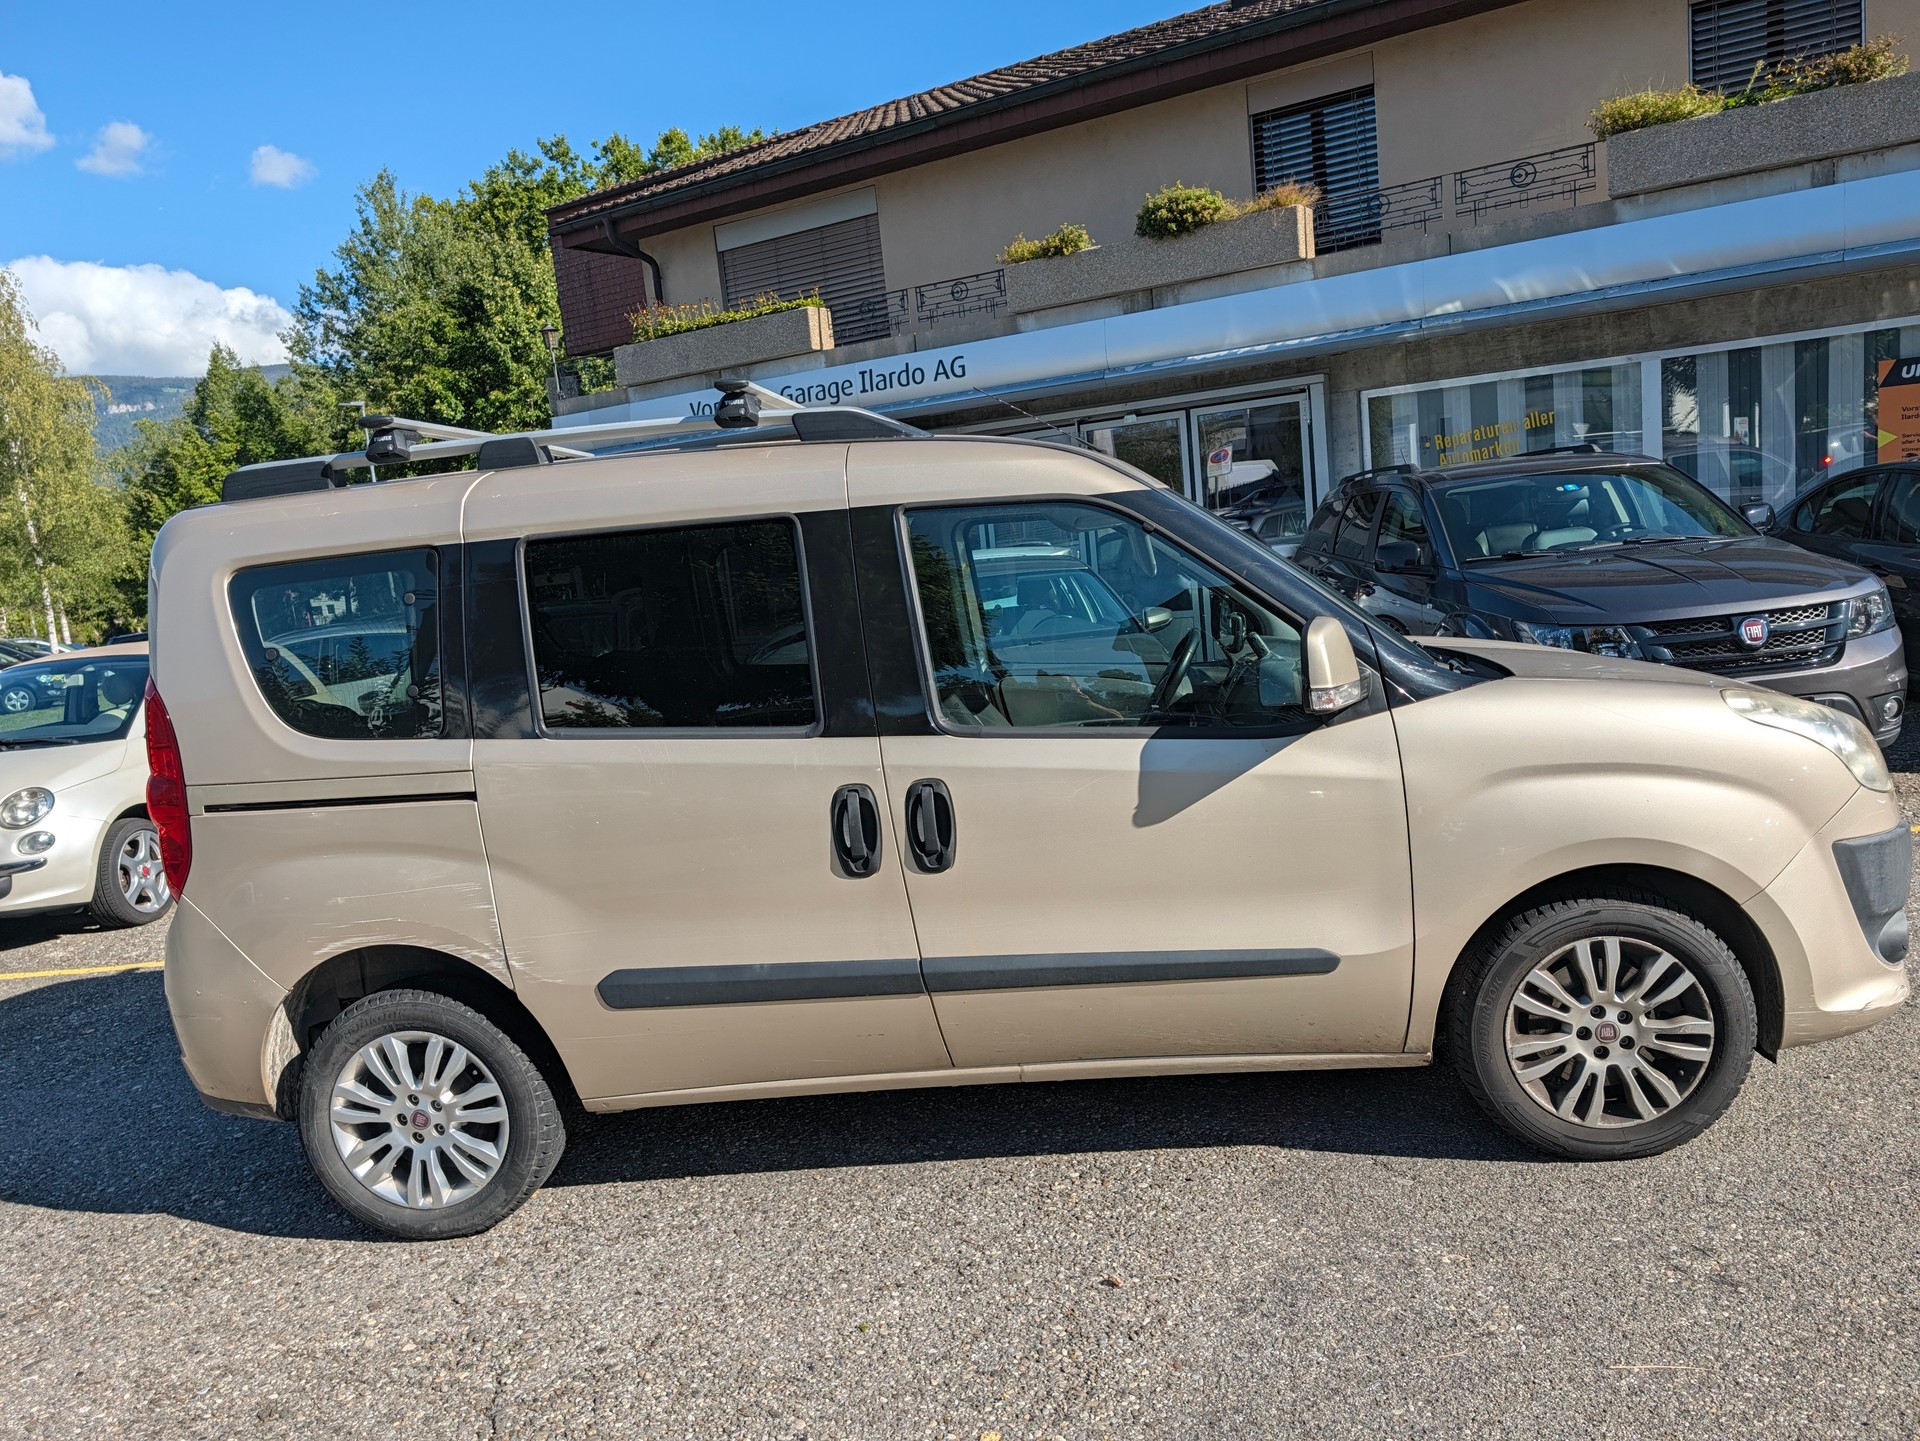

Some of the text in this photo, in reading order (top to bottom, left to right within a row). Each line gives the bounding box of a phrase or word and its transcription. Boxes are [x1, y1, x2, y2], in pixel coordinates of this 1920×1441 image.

[780, 379, 853, 405] Garage
[858, 362, 925, 394] Ilardo
[933, 355, 966, 382] AG
[1901, 412, 1920, 420] Ilard
[1434, 410, 1555, 450] Reparaturen aller
[1440, 441, 1519, 466] Automarken
[1746, 625, 1762, 638] FIAT
